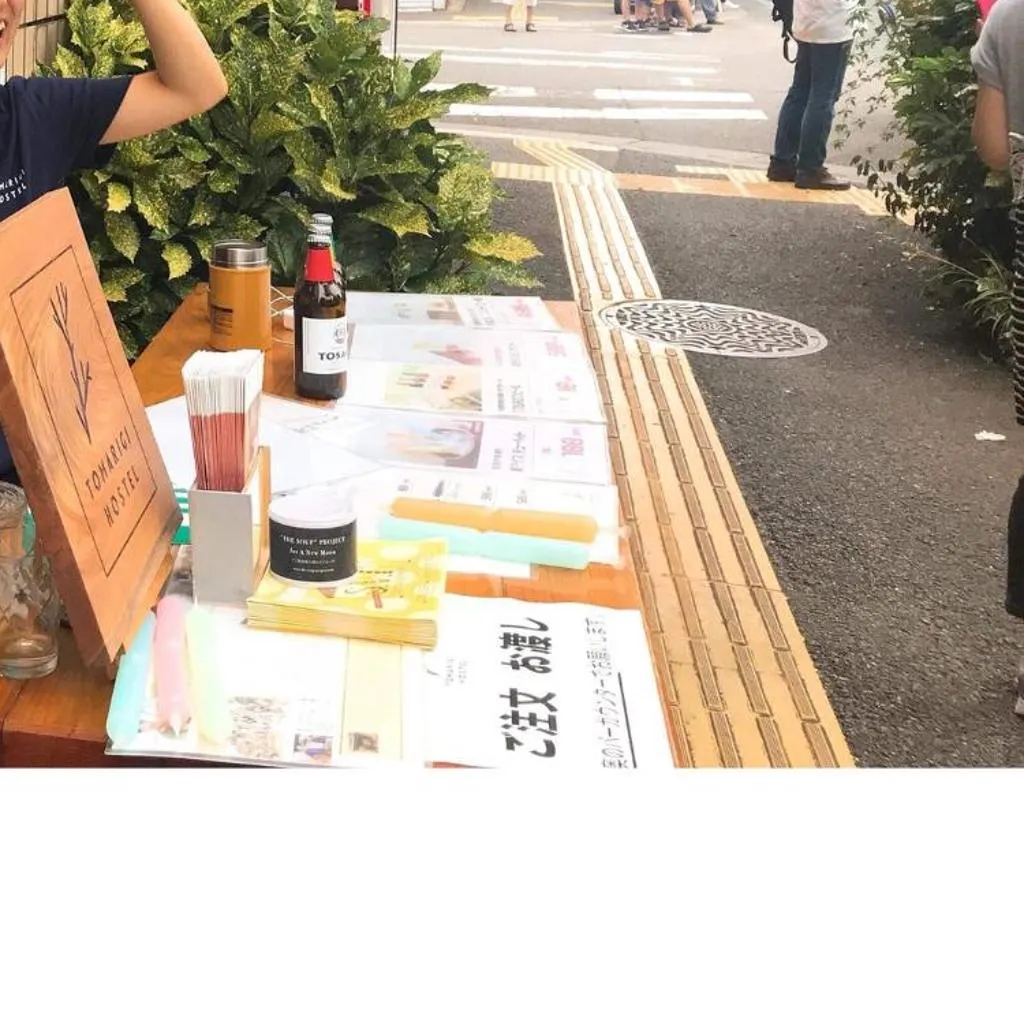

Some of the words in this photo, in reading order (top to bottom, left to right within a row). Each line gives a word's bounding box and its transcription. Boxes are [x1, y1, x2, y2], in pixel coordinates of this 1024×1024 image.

[85, 425, 132, 501] TOMARIGI
[103, 464, 140, 527] HOSTEL
[499, 617, 553, 674] お渡し
[499, 687, 558, 759] ご注文
